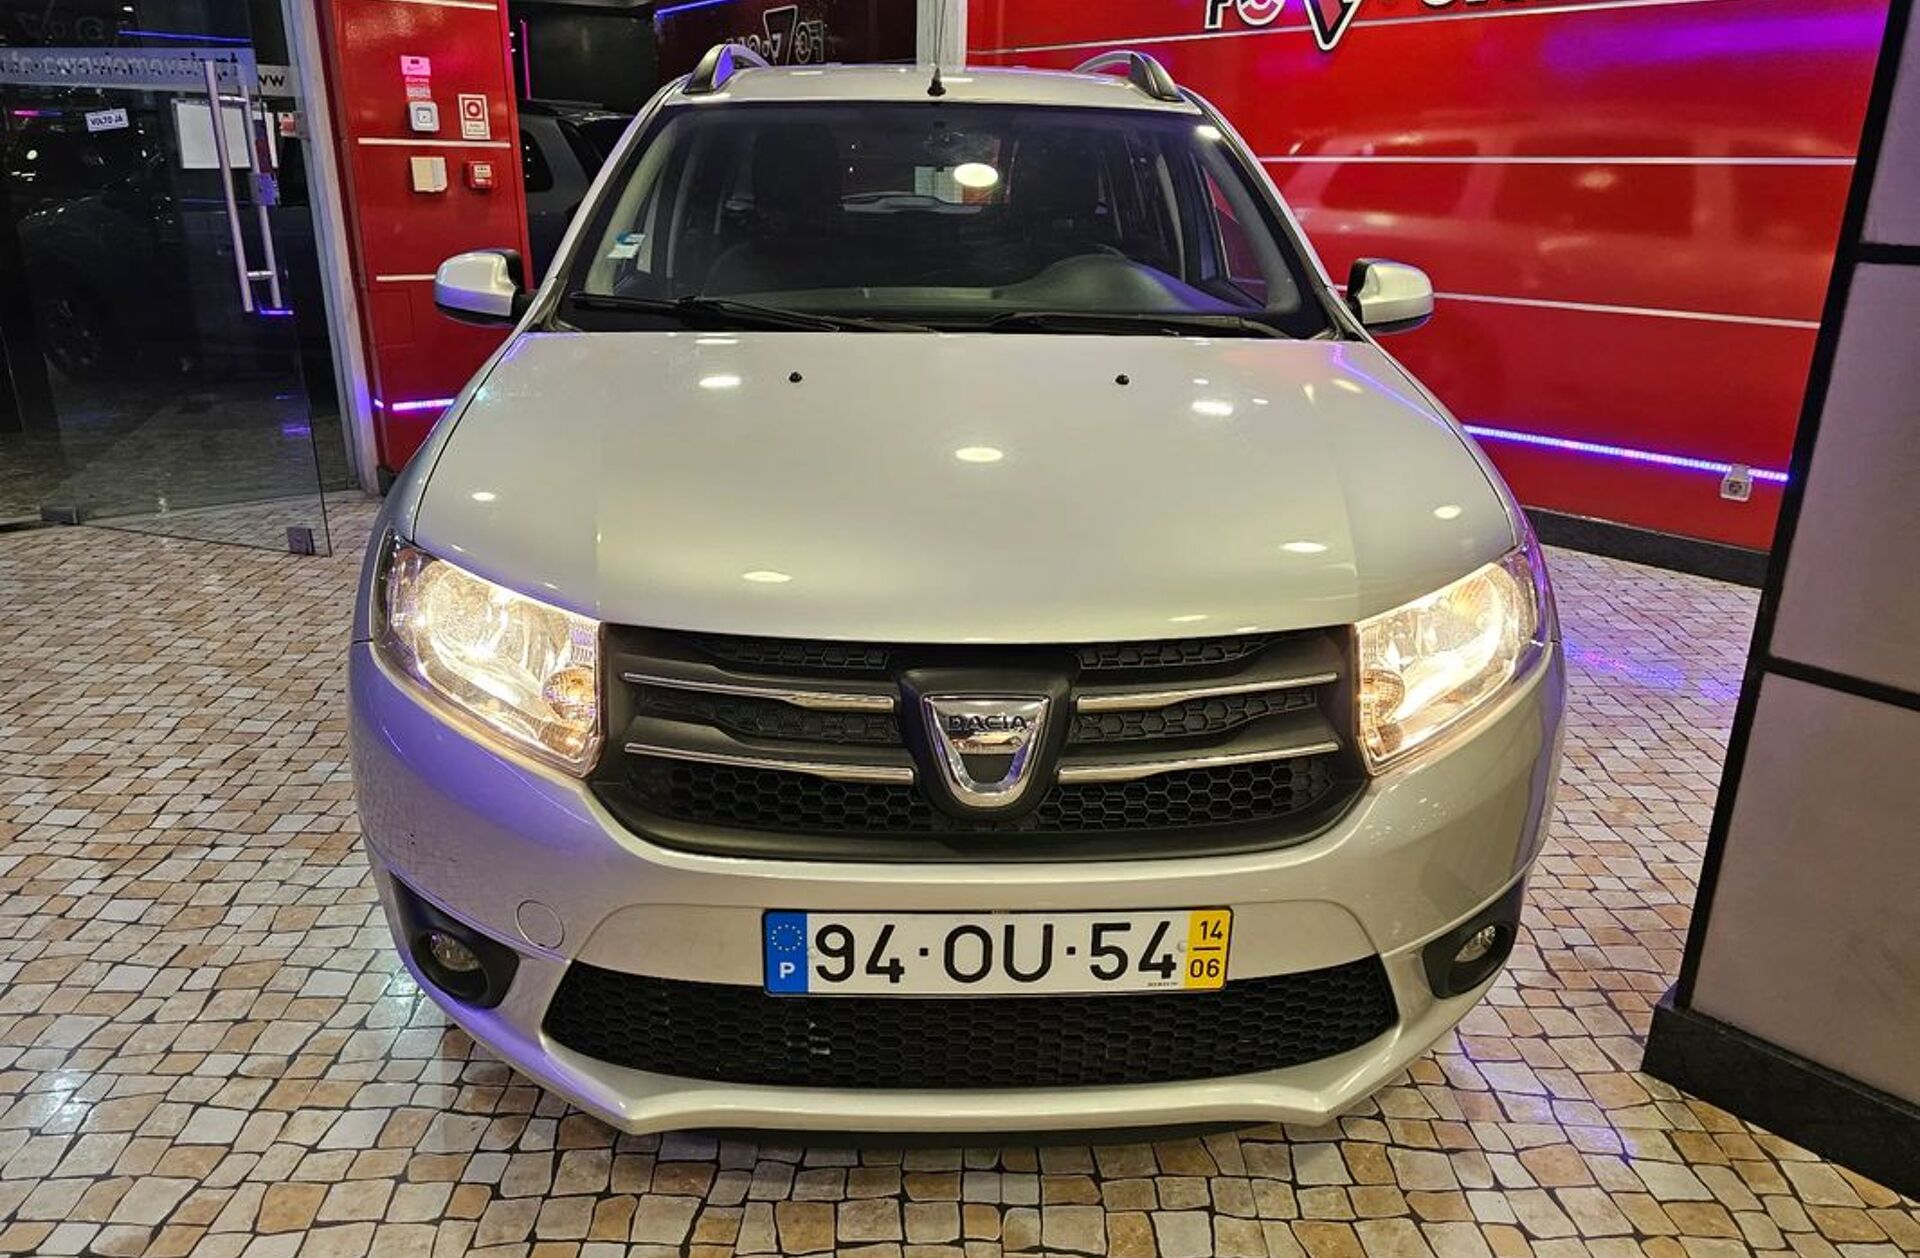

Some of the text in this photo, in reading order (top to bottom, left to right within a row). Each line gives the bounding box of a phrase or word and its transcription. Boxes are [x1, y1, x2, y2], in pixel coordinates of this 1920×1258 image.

[948, 715, 1028, 731] DACIA
[1200, 920, 1223, 941] 14
[779, 962, 795, 979] P
[1189, 958, 1220, 978] 06
